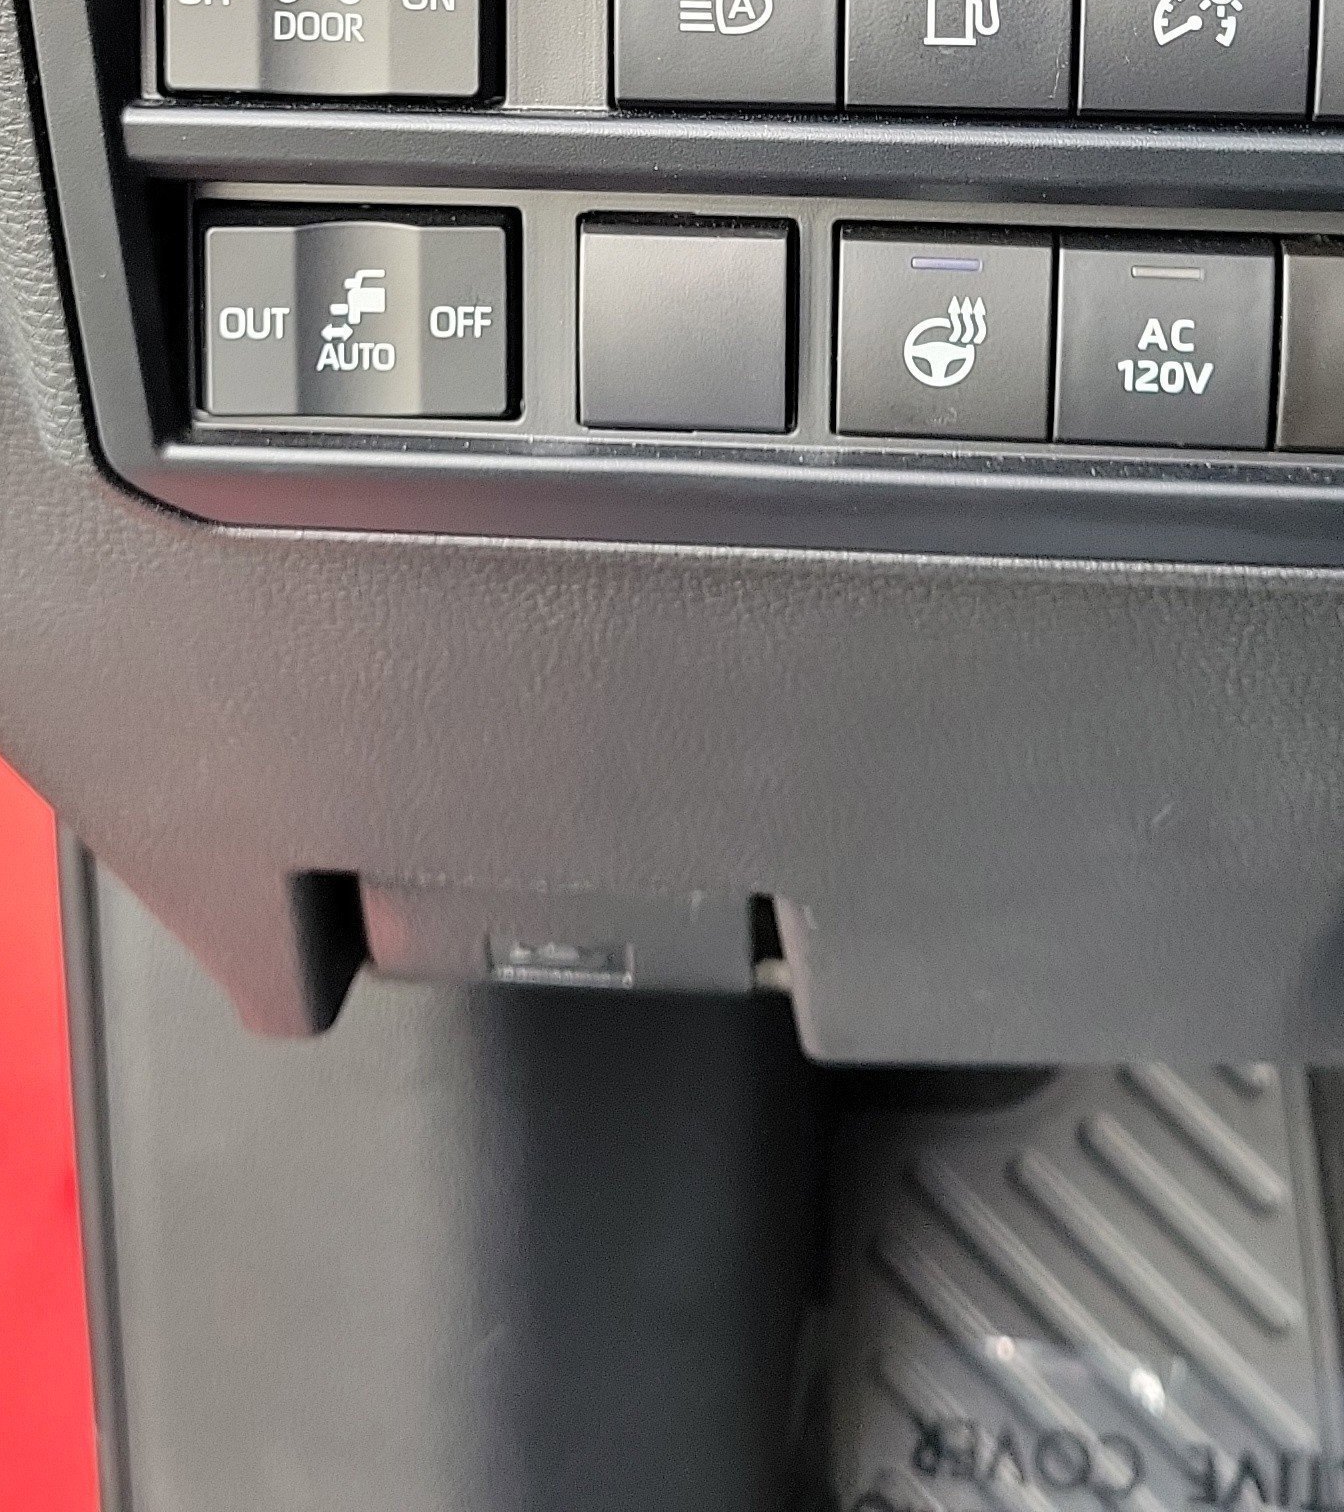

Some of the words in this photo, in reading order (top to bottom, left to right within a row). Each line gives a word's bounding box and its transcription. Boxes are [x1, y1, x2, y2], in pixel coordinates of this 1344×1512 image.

[274, 11, 365, 42] DOOR
[219, 306, 290, 340] OUT
[430, 305, 492, 338] OFF
[1137, 318, 1195, 352] AC
[317, 342, 395, 371] AUTO
[1117, 359, 1214, 394] 120V
[911, 1423, 1141, 1491] COVER
